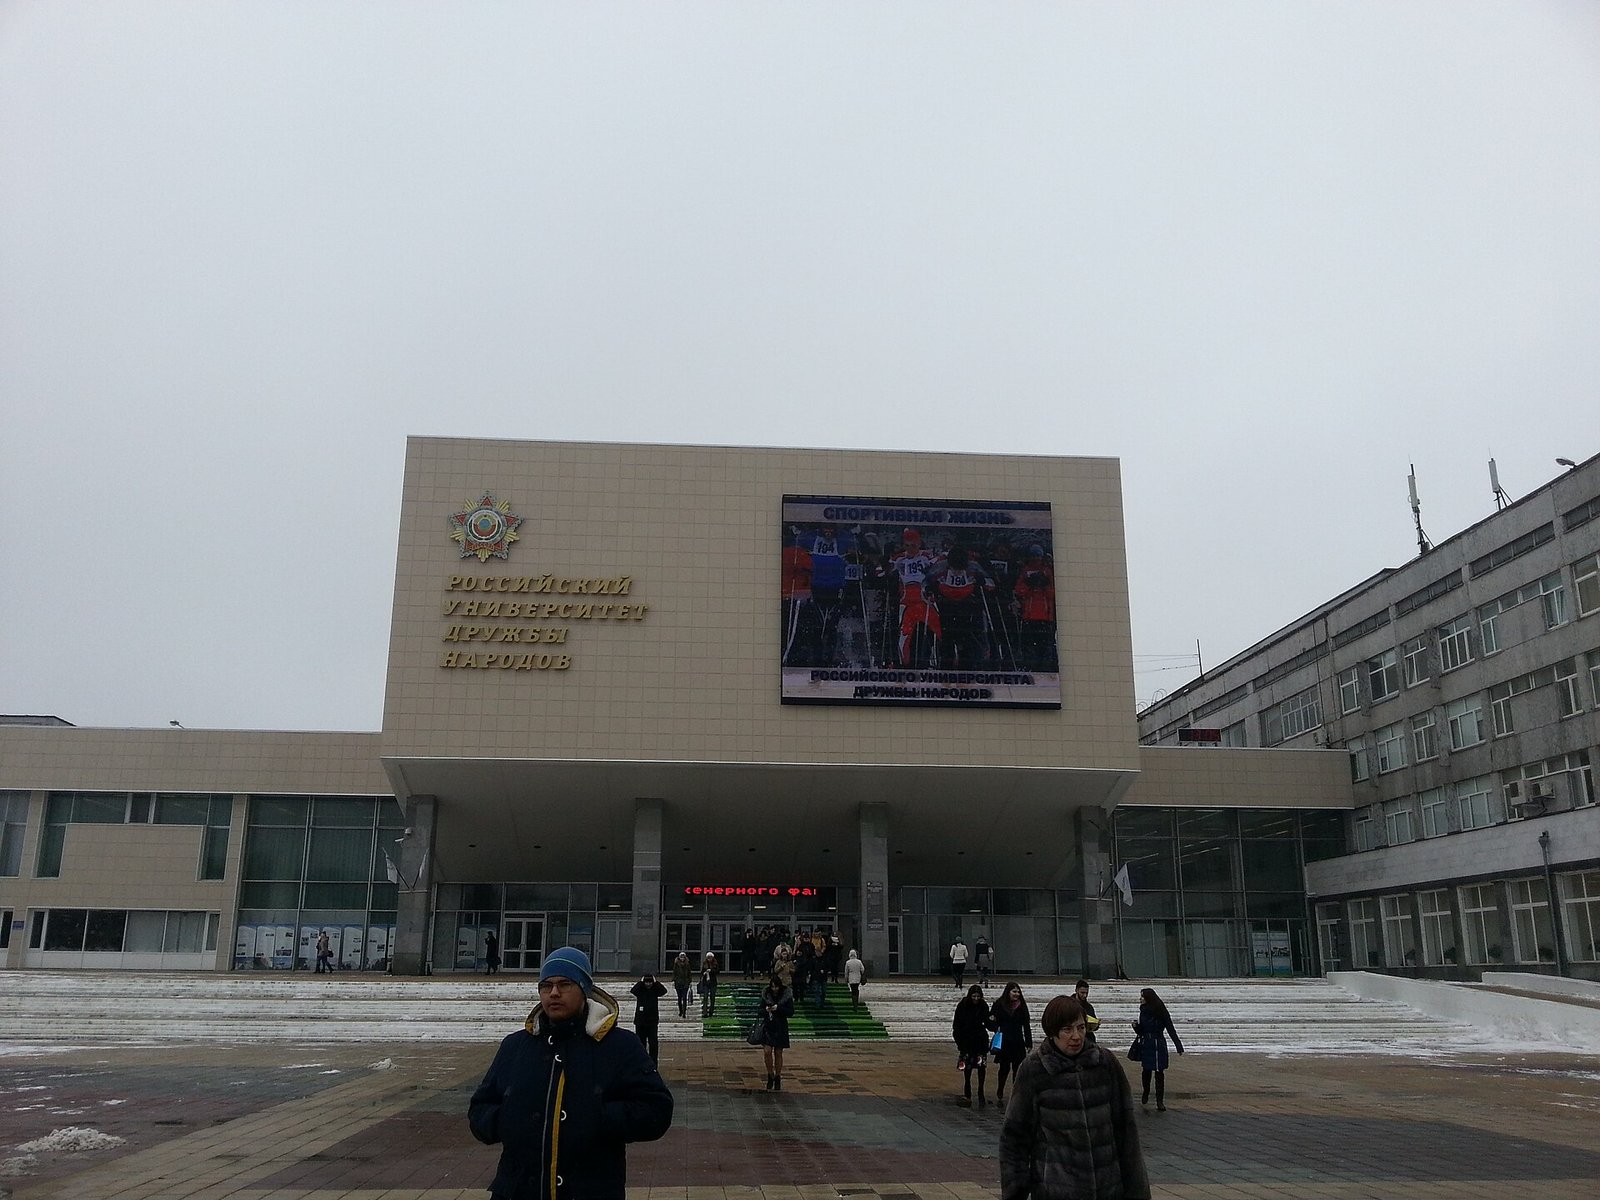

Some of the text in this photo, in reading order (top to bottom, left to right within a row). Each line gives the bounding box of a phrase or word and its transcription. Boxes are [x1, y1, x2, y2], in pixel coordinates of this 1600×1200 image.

[823, 507, 1016, 525] СПОРТИВНАЯ ЖИЗНЬ
[908, 560, 923, 574] 195
[445, 573, 632, 594] РОССИЙСКИЙ
[443, 600, 648, 620] УНИВЕРСИТЕТ
[442, 624, 569, 643] ДРУЖБЫ
[440, 651, 571, 671] НАРОДОВ
[810, 668, 1033, 685] РОССИЙСКОГО УНИВЕРСИТЕТА
[853, 686, 992, 700] ДРУЖБЫ НАРОДОВ
[788, 887, 817, 896] фа
